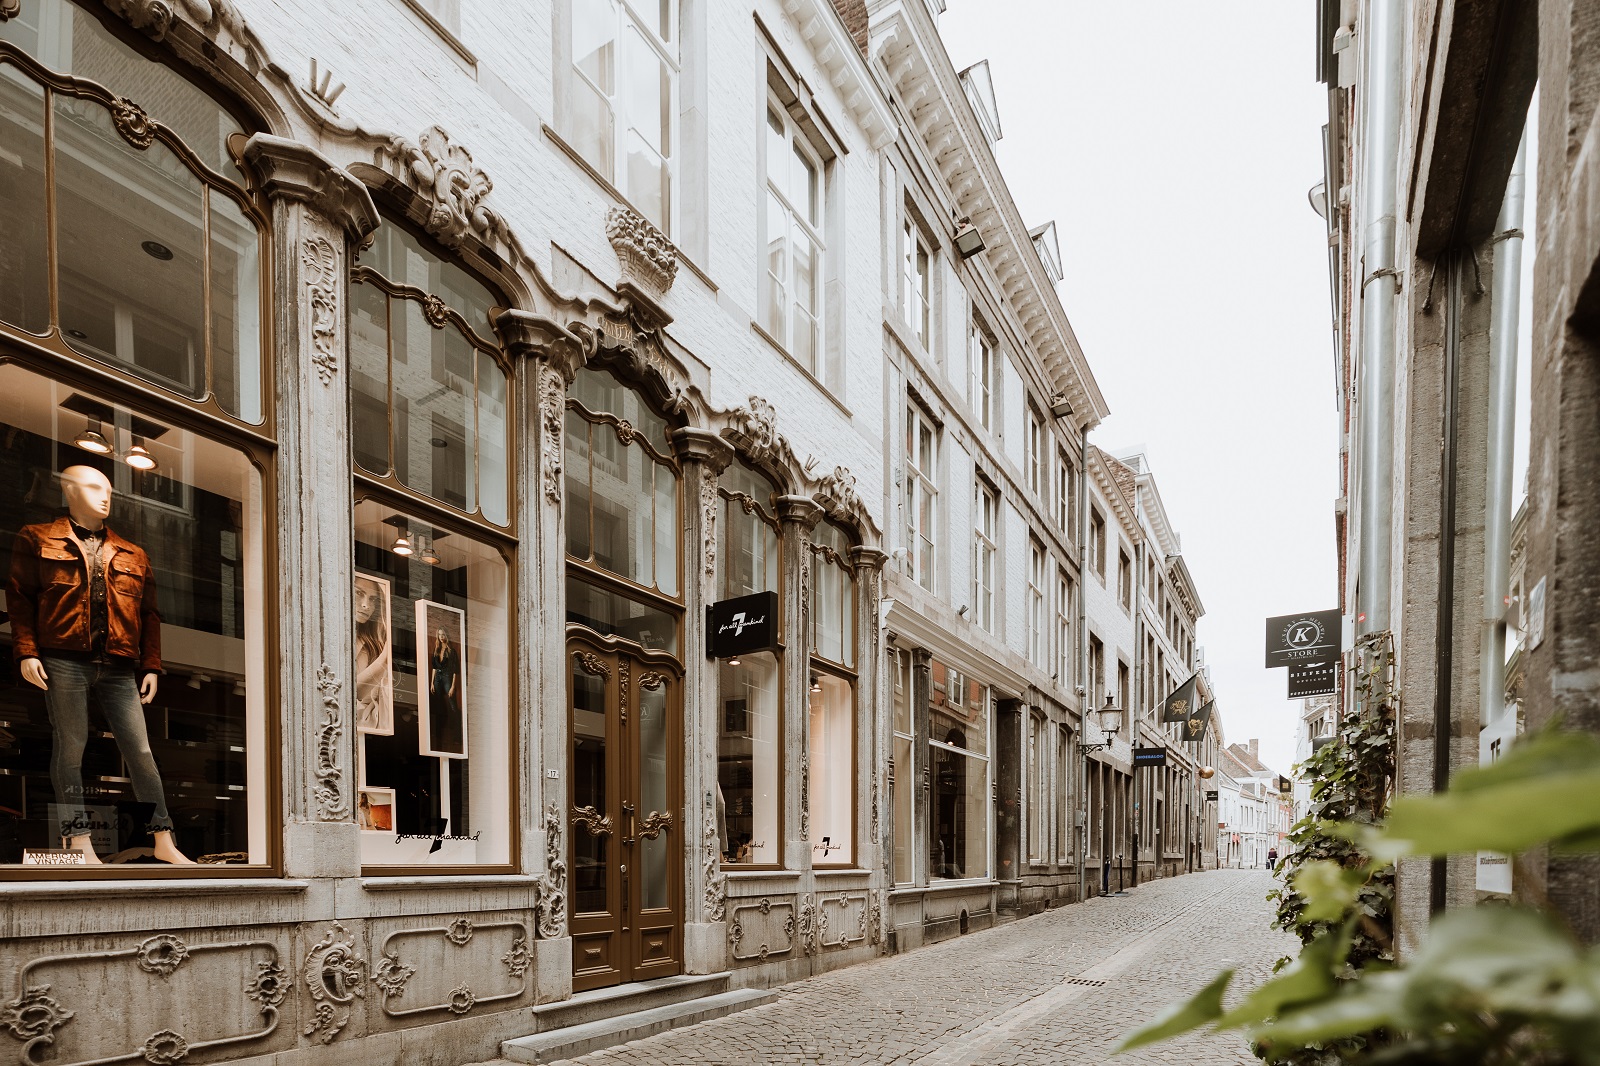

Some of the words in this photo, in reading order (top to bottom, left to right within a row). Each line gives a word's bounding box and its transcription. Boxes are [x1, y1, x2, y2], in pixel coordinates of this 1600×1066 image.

[732, 612, 746, 636] 7
[1292, 627, 1314, 643] K
[1288, 649, 1318, 658] STORE
[822, 837, 831, 857] 7
